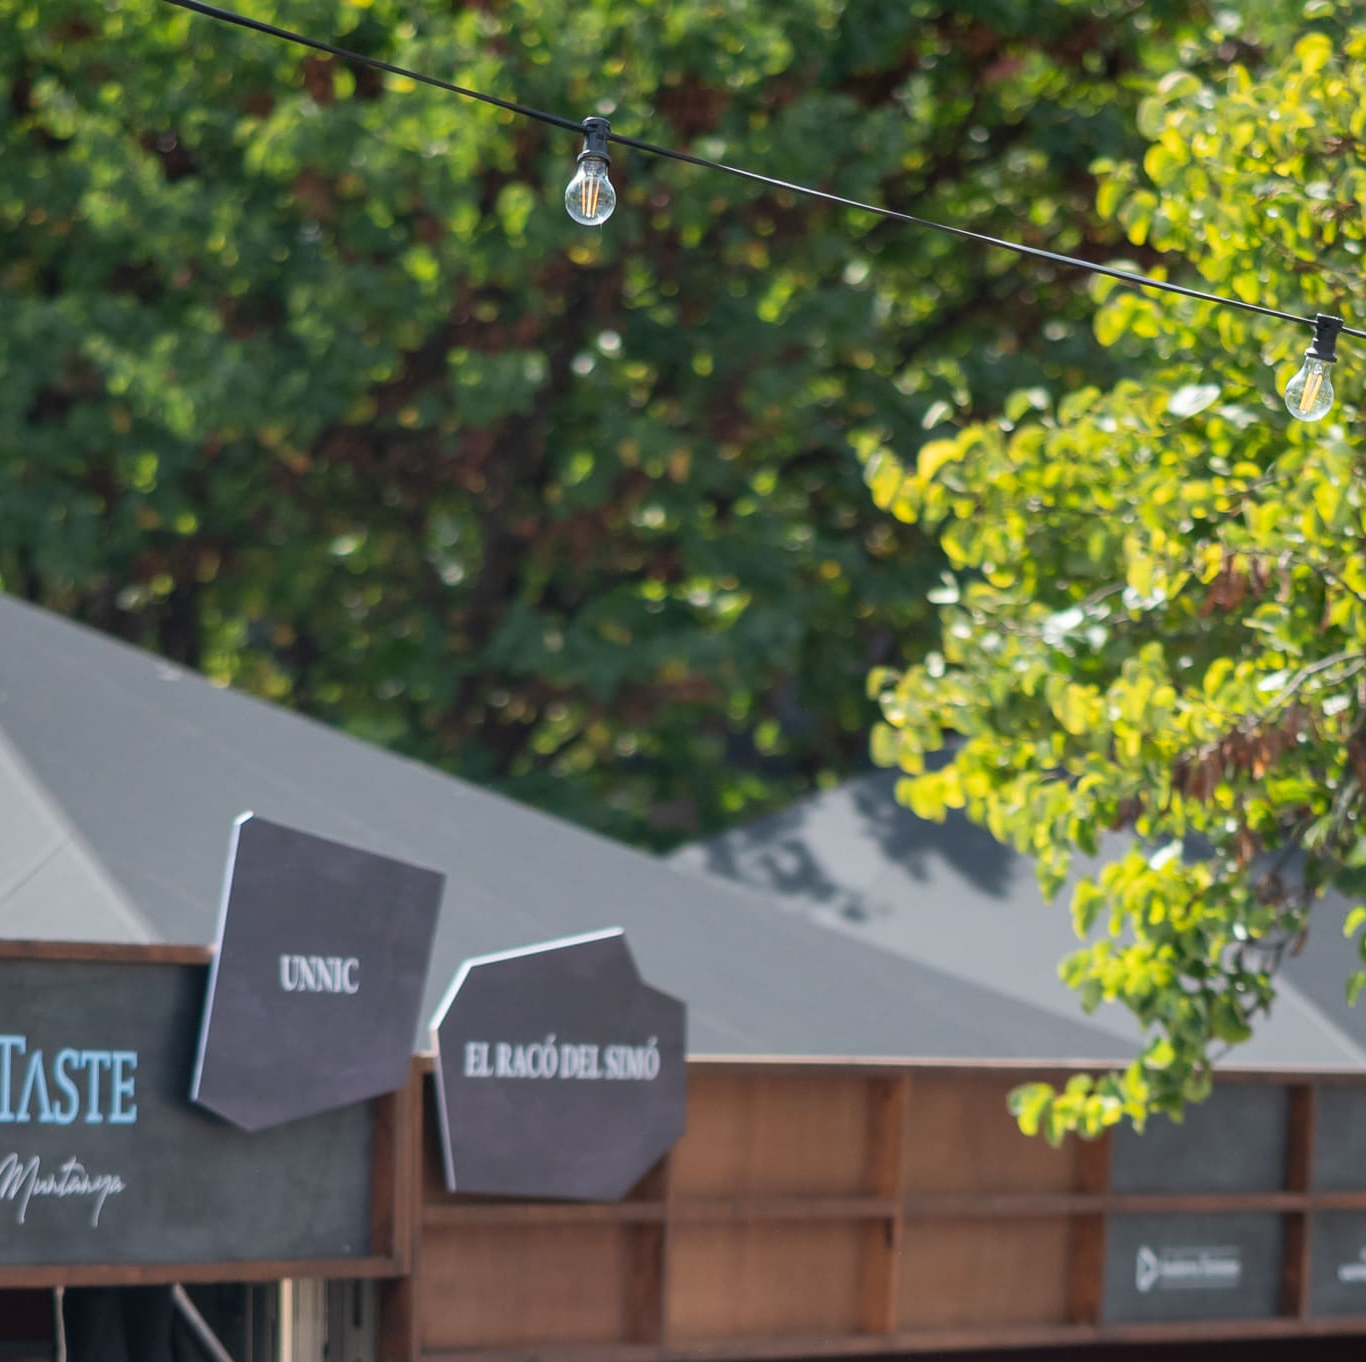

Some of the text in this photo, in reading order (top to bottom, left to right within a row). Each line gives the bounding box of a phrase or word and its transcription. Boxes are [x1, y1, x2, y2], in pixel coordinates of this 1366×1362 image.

[280, 955, 359, 994] UNNIC
[464, 1034, 661, 1081] EL RACÓ DEL SIMÓ
